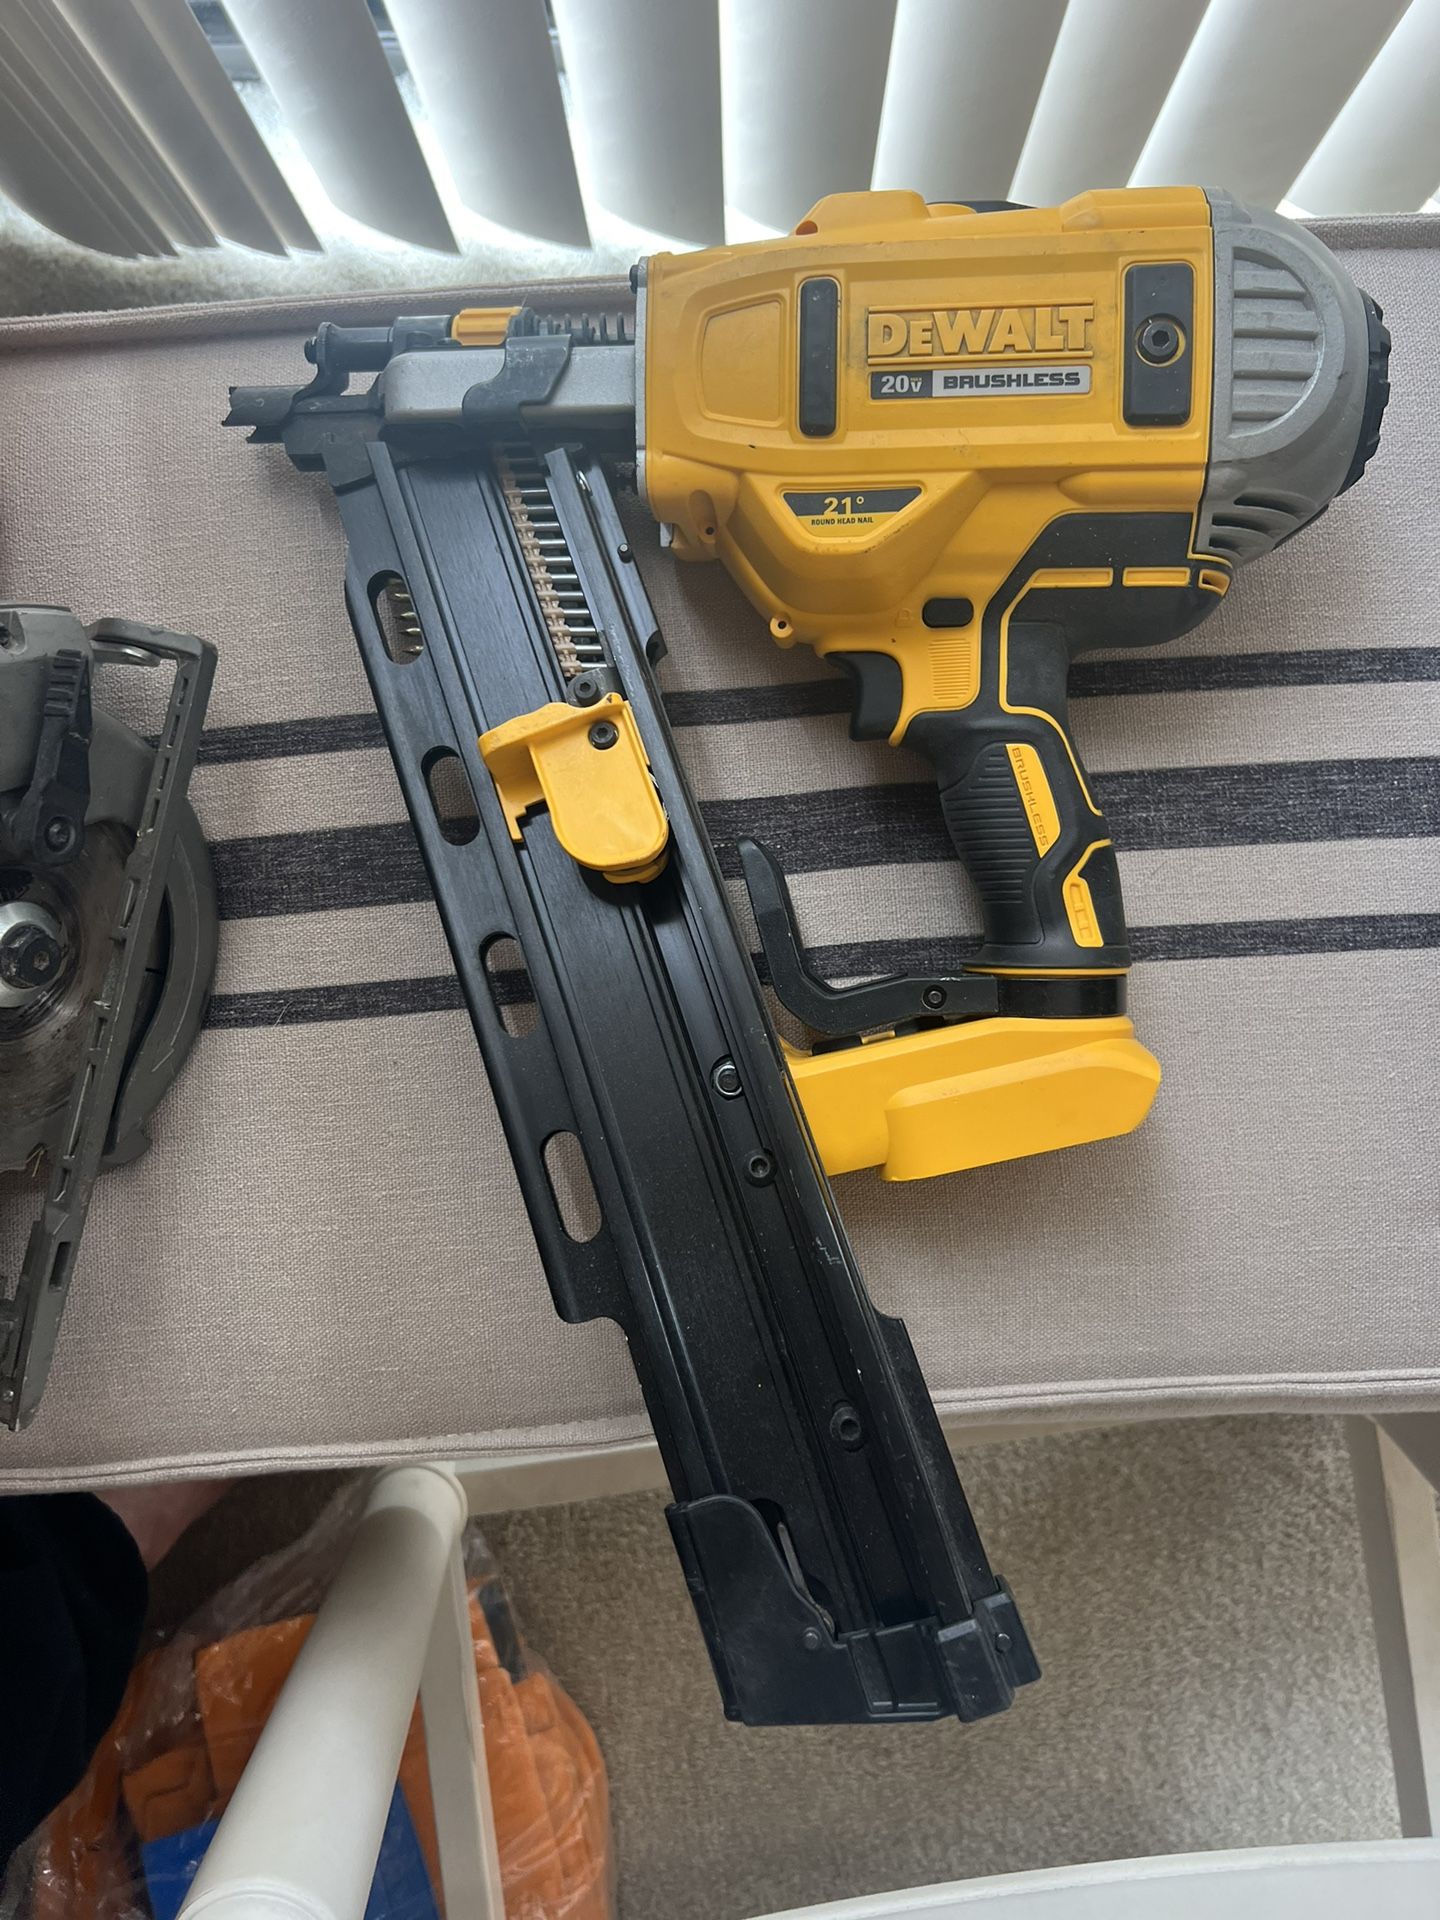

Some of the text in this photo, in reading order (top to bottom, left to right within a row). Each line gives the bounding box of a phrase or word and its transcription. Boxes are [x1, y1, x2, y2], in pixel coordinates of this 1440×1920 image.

[943, 372, 1081, 390] BRUSHLESS
[811, 516, 874, 526] ROUND HEAD NAIL
[1011, 747, 1050, 847] BRUSHLESS
